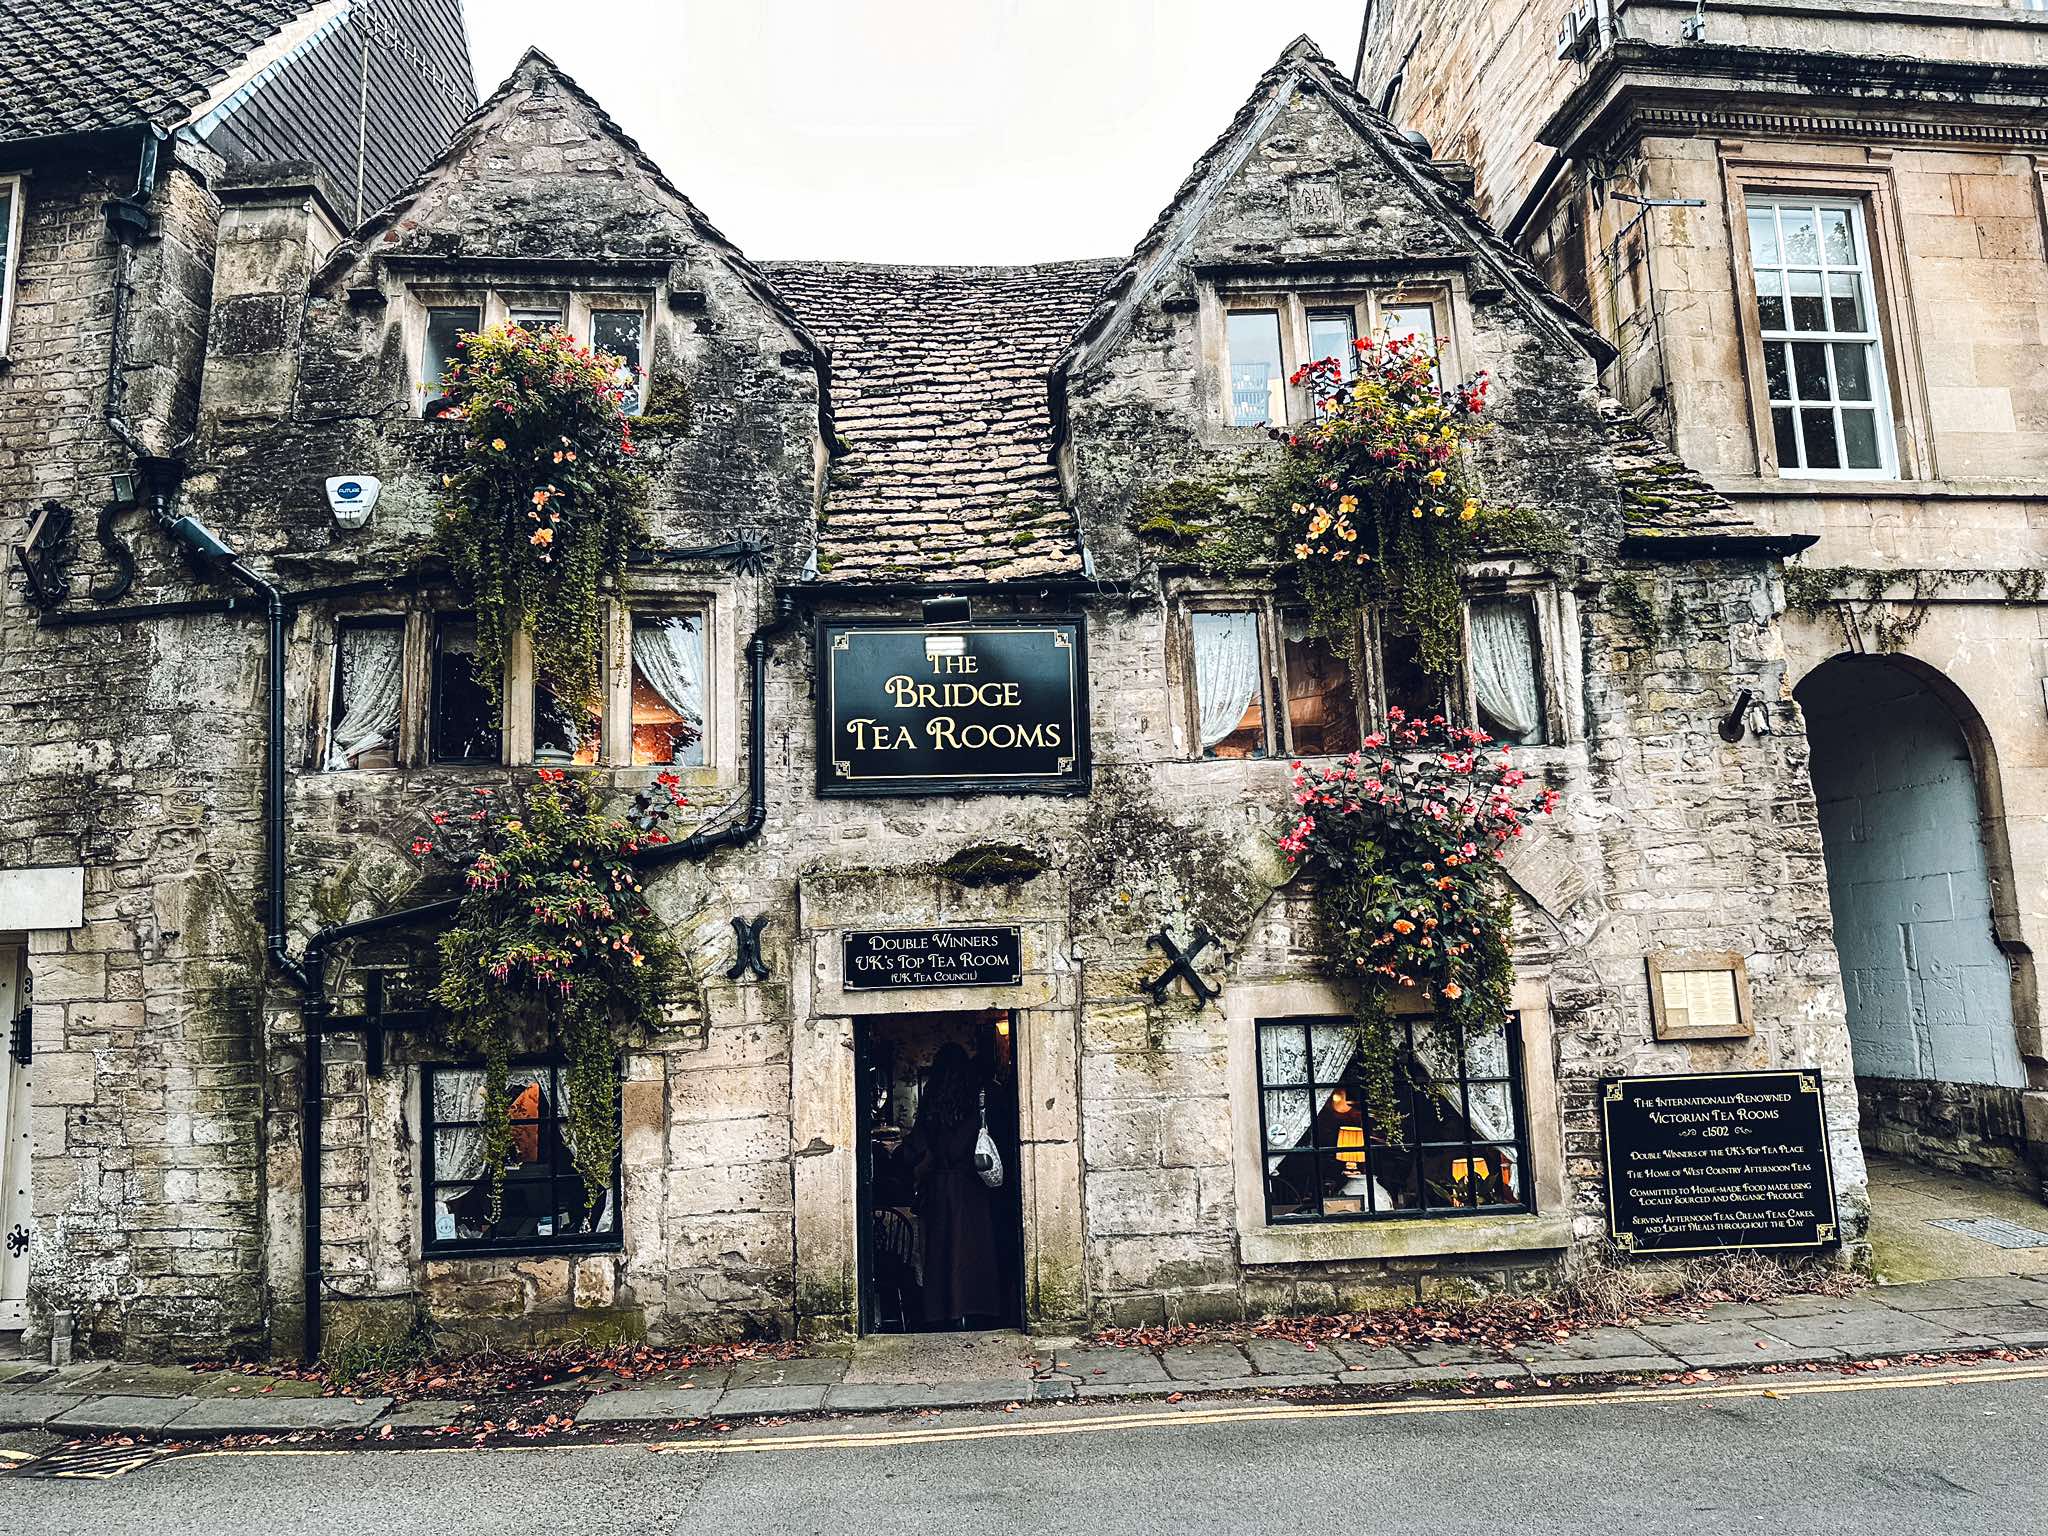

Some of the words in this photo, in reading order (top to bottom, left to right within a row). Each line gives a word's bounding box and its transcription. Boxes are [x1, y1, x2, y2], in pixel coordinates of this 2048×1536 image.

[927, 653, 979, 674] THE
[884, 675, 1022, 708] BRIDGE
[846, 718, 918, 751] TEA
[925, 716, 1061, 750] ROOMS
[868, 936, 929, 951] DOUBLE
[932, 933, 999, 948] WINNERS
[897, 954, 925, 969] TOP
[927, 953, 956, 968] TEA
[959, 952, 1010, 967] ROOM
[913, 972, 932, 983] TEA
[933, 970, 978, 983] COUNCIL)
[1633, 1097, 1655, 1108] THE
[1655, 1095, 1737, 1107] INTERNATIONALLY
[1735, 1092, 1792, 1104] RENOWNED
[1649, 1111, 1711, 1124] VICTORIAN
[1711, 1109, 1736, 1121] TEA
[1736, 1107, 1780, 1120] ROOMS
[1630, 1151, 1662, 1160] DOUBLE
[1662, 1149, 1698, 1158] WINNERS
[1697, 1149, 1708, 1157] OF
[1709, 1149, 1724, 1157] THE
[1745, 1146, 1761, 1155] TOP
[1761, 1145, 1778, 1155] TEA
[1778, 1144, 1805, 1154] PLACE
[1626, 1170, 1643, 1179] THE
[1644, 1169, 1671, 1178] HOME
[1682, 1167, 1704, 1176] WEST
[1705, 1166, 1742, 1175] COUNTRY
[1743, 1164, 1791, 1174] AFTERNOON
[1790, 1162, 1812, 1172] TEAS
[1629, 1188, 1678, 1197] COMMITTED
[1678, 1187, 1690, 1195] TO
[1690, 1185, 1742, 1194] HOME-MADE
[1742, 1182, 1766, 1192] FOOD
[1767, 1183, 1790, 1191] MADE
[1790, 1182, 1812, 1190] USING
[1639, 1197, 1673, 1206] LOCALLY
[1674, 1195, 1711, 1205] SOURCED
[1711, 1195, 1729, 1203] AND
[1729, 1192, 1766, 1202] ORGANIC
[1766, 1191, 1805, 1200] PRODUCE
[1632, 1216, 1664, 1225] SERVING
[1665, 1214, 1713, 1223] AFTERNOON
[1735, 1210, 1765, 1220] CREAM
[1644, 1226, 1662, 1234] AND
[1662, 1224, 1687, 1233] LIGHT
[1687, 1222, 1716, 1232] MEALS
[1716, 1221, 1769, 1230] THROUGHOUT
[1770, 1220, 1786, 1228] THE
[1785, 1218, 1804, 1227] DAY
